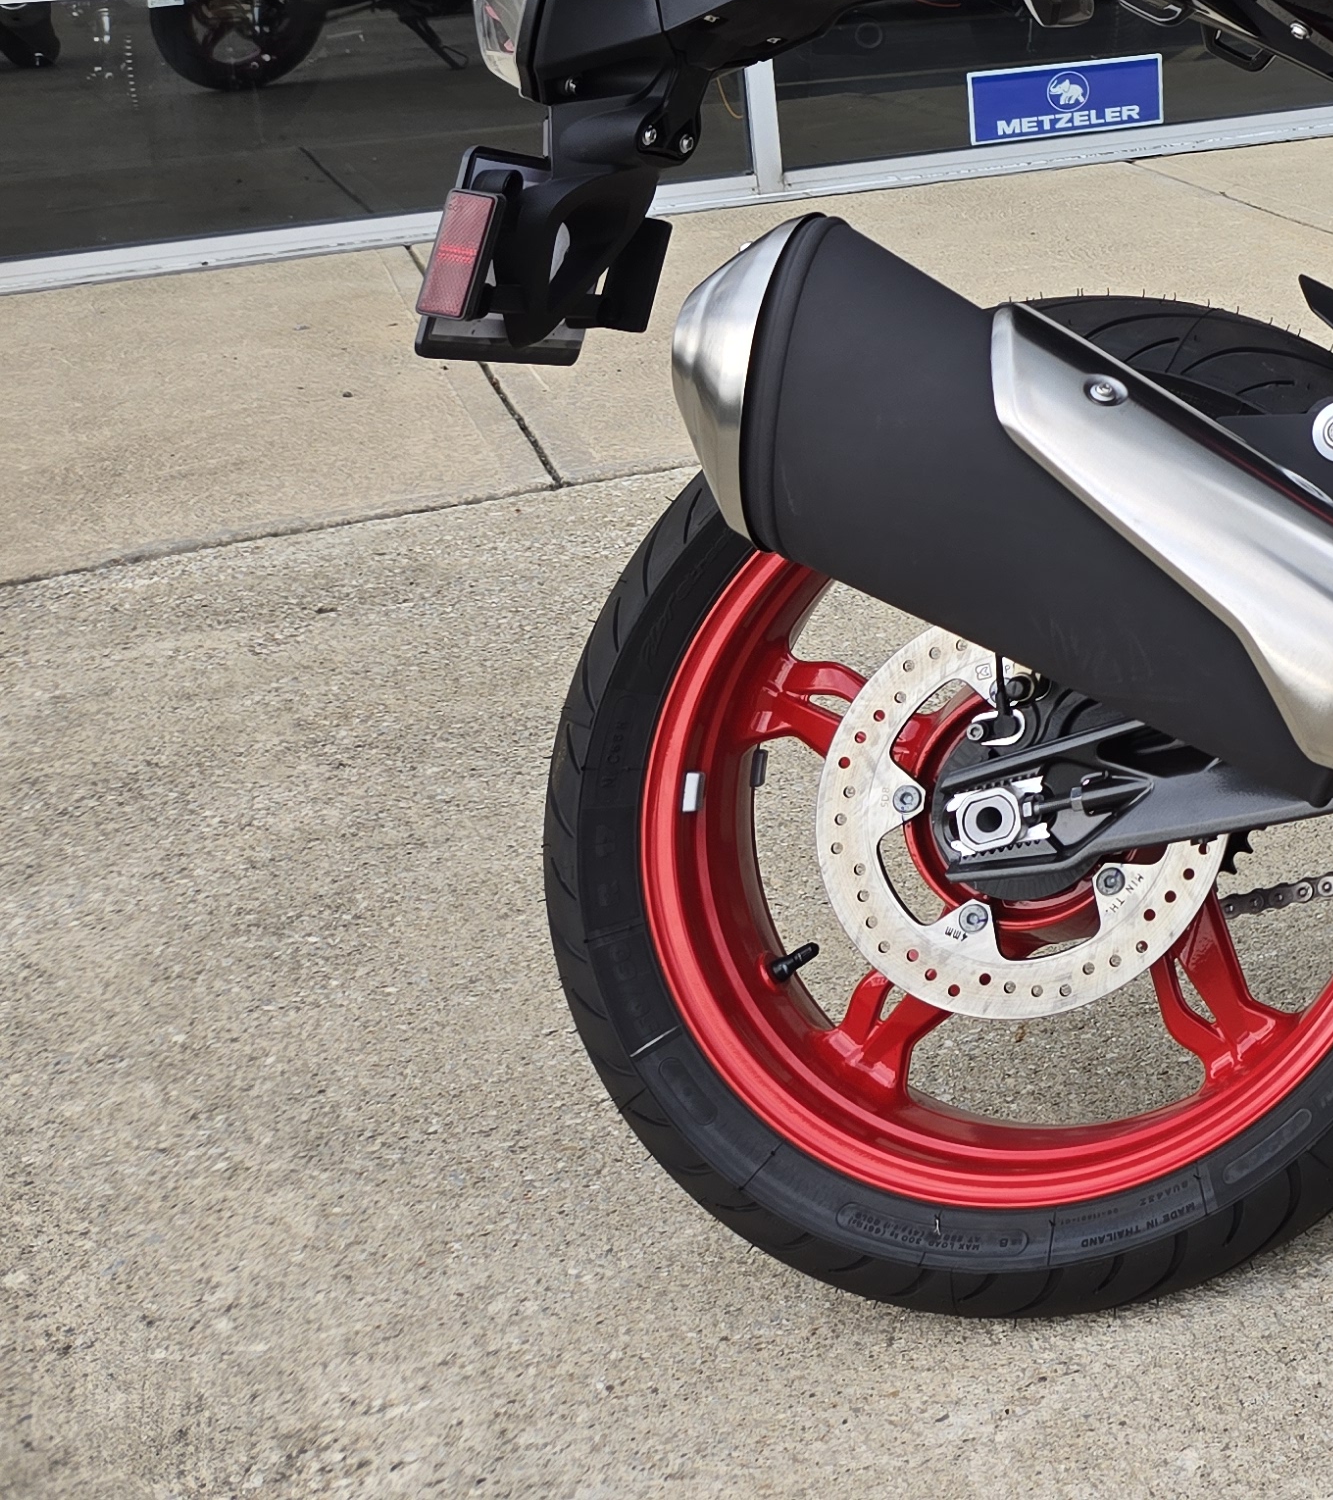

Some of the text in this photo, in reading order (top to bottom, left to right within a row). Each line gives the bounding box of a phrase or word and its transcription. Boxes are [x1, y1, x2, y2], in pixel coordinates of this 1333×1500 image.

[996, 105, 1140, 136] METZELER
[1125, 873, 1144, 893] MIN
[1080, 1202, 1197, 1250] MADE IN THAILAND
